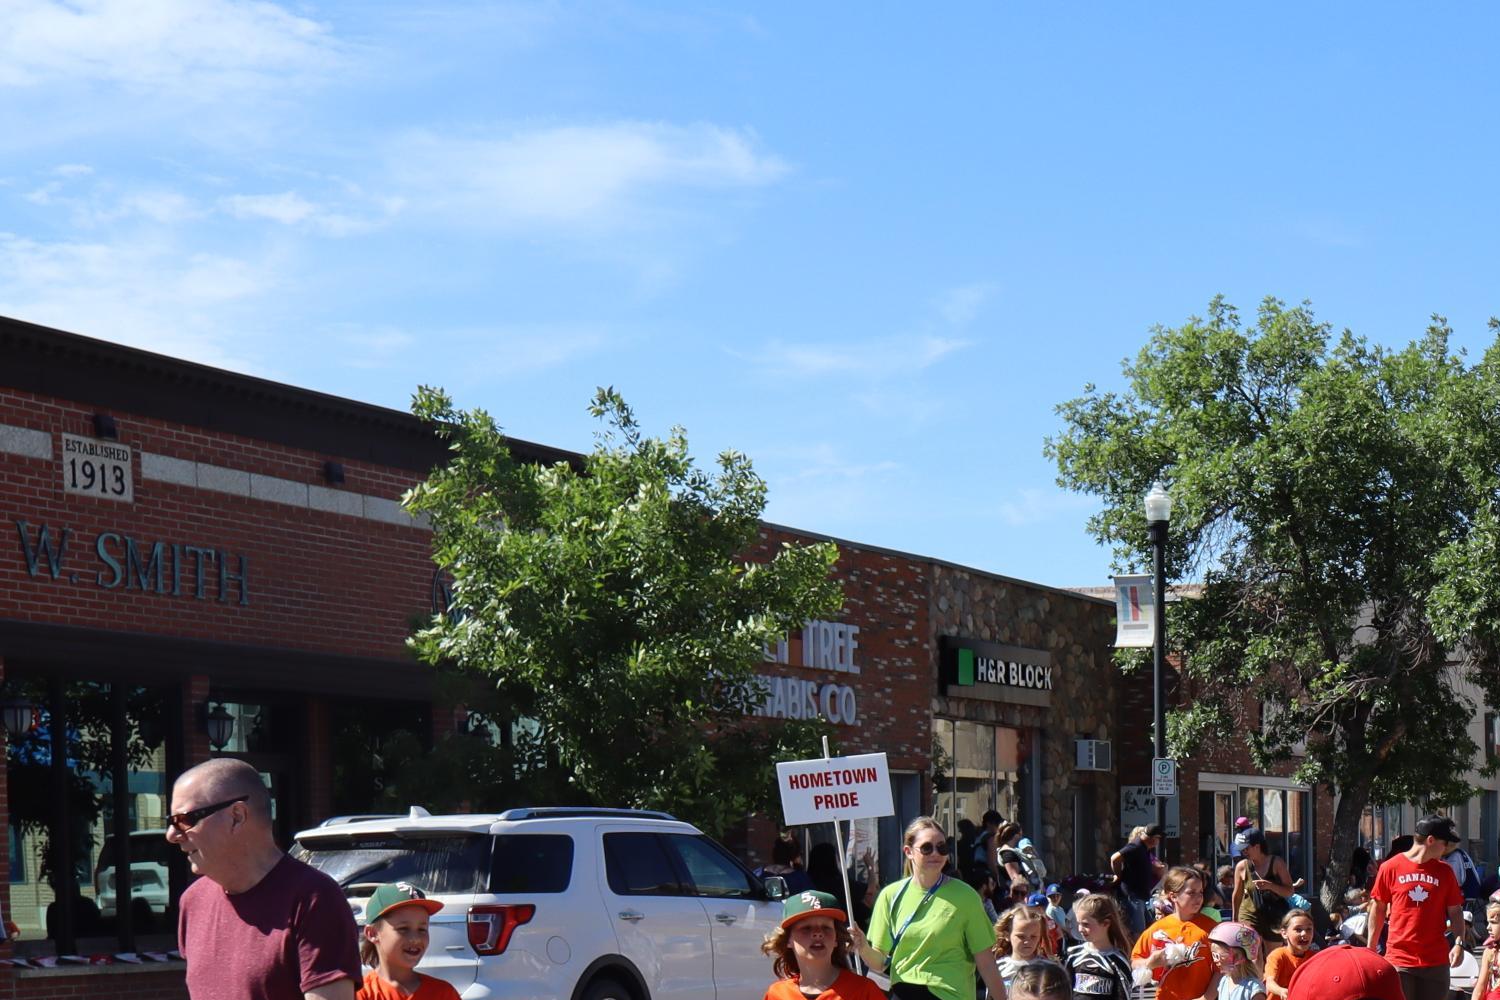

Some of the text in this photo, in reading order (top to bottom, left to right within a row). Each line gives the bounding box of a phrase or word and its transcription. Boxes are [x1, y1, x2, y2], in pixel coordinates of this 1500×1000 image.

[65, 438, 129, 462] ESTABLISHED
[69, 458, 126, 496] 1913
[96, 532, 249, 606] SMITH
[803, 619, 861, 674] TREE
[978, 657, 1052, 690] H&R BLOCK
[820, 683, 862, 727] CO.
[788, 767, 878, 790] HOMETOWN
[813, 792, 859, 810] PRIDE
[1398, 873, 1440, 887] CANADA
